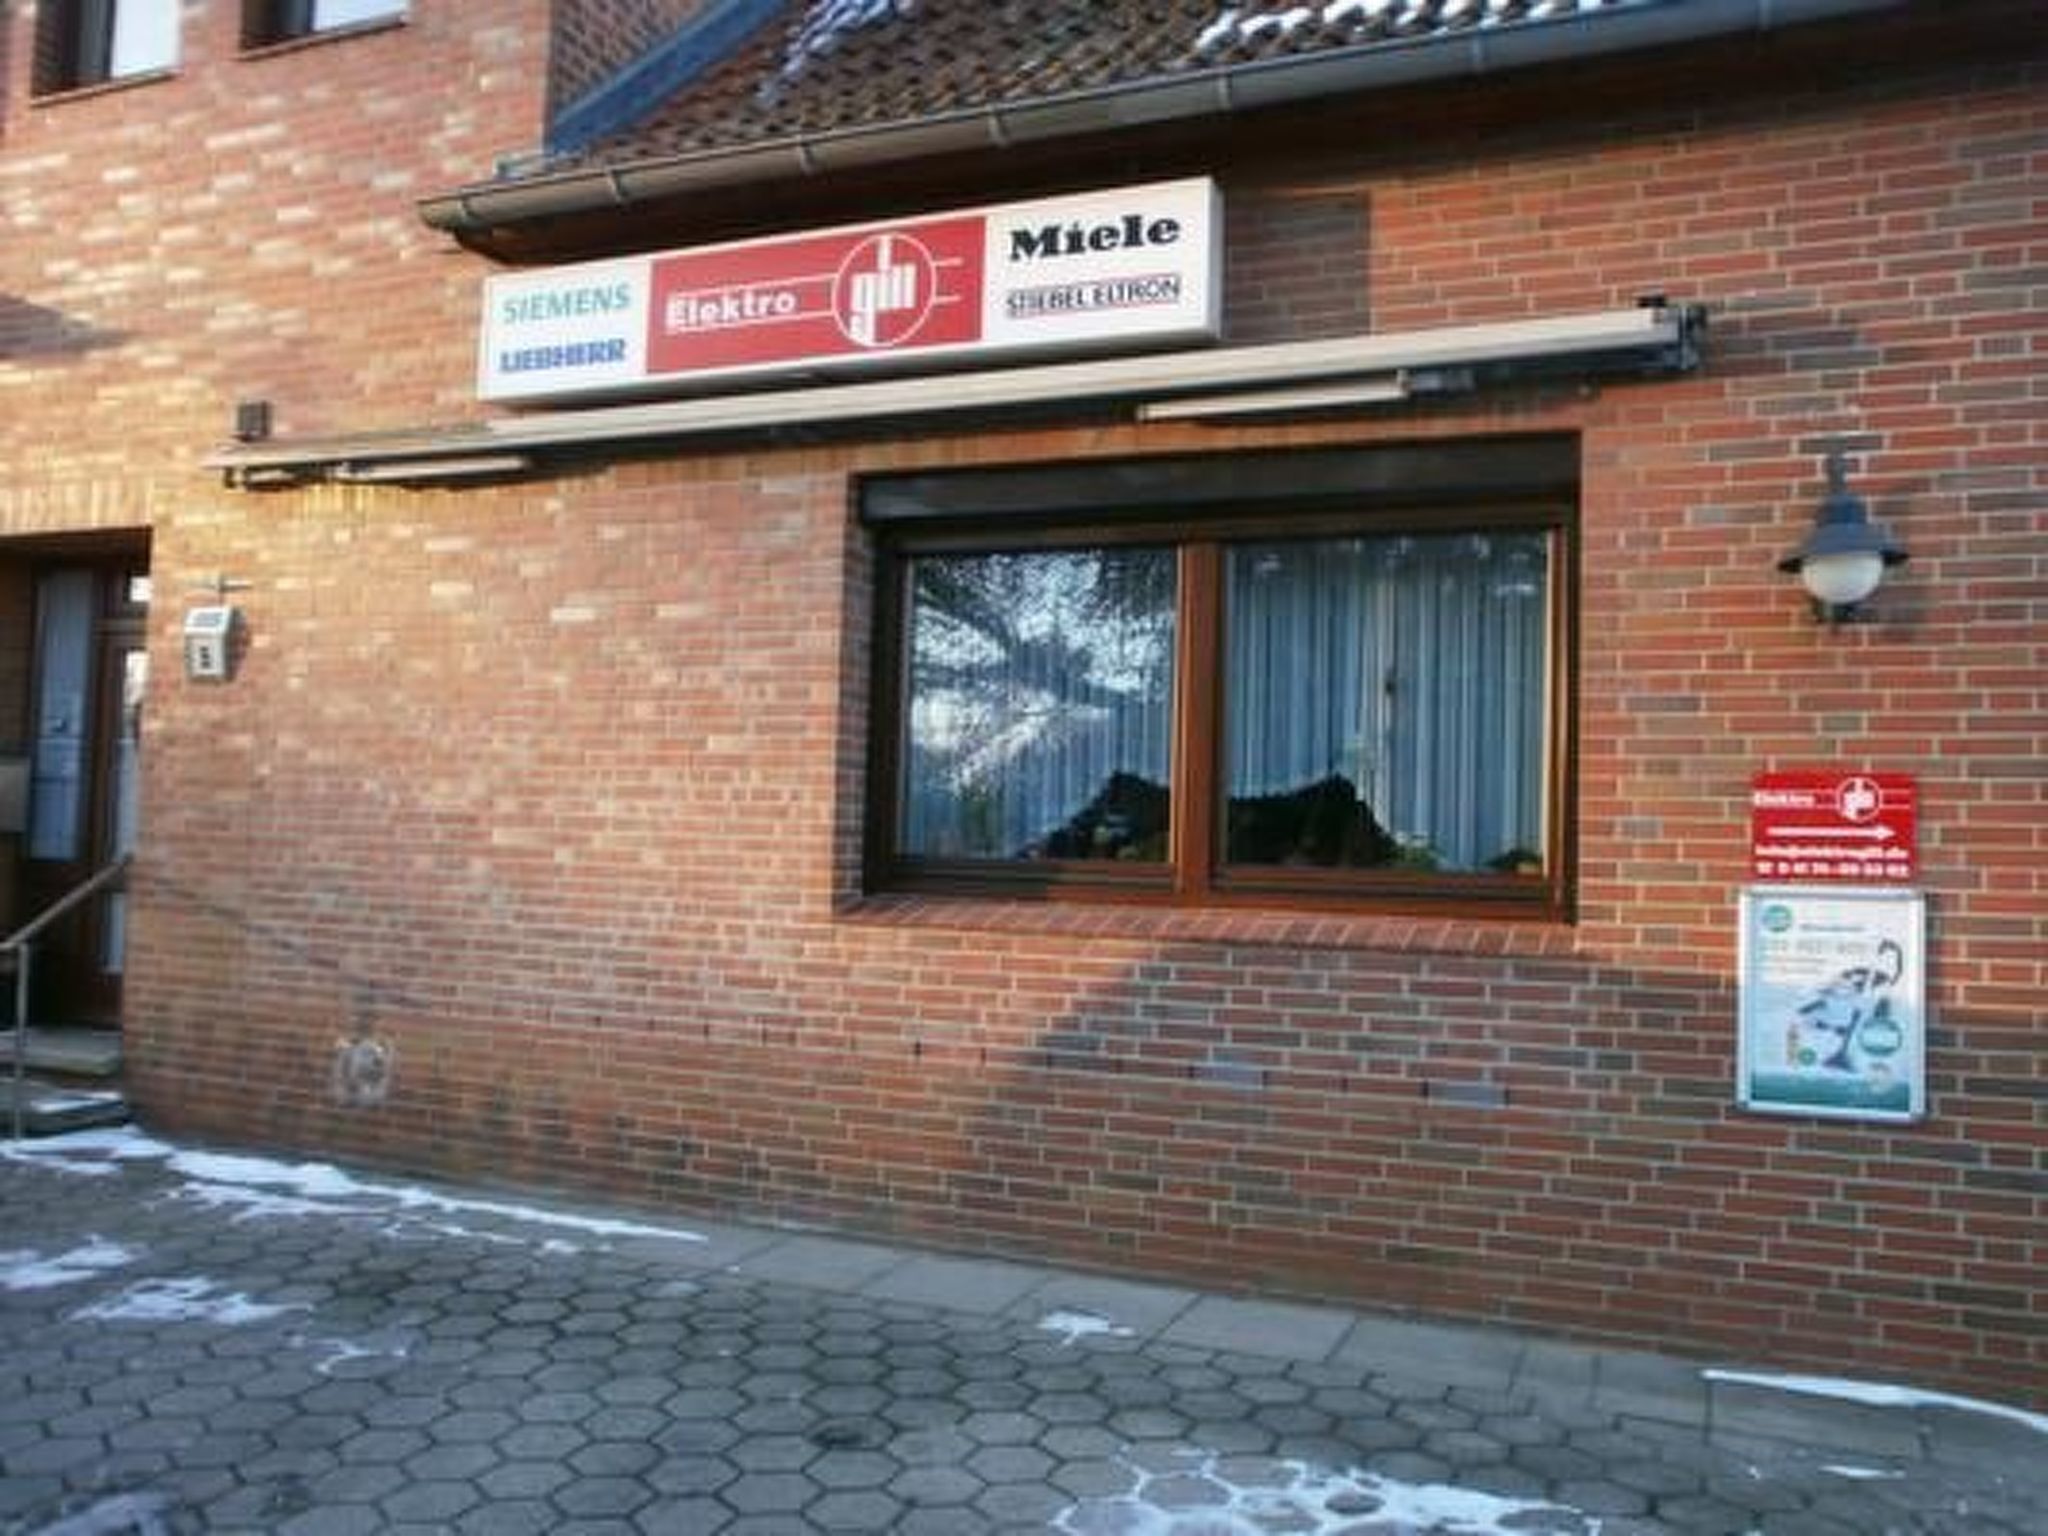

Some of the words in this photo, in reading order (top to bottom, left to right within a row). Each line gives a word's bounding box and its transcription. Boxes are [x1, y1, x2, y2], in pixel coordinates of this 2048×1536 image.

[1010, 214, 1181, 262] Miele
[502, 283, 631, 325] SIEMENS
[665, 290, 798, 332] Elektro
[500, 339, 626, 372] LIEBHERR
